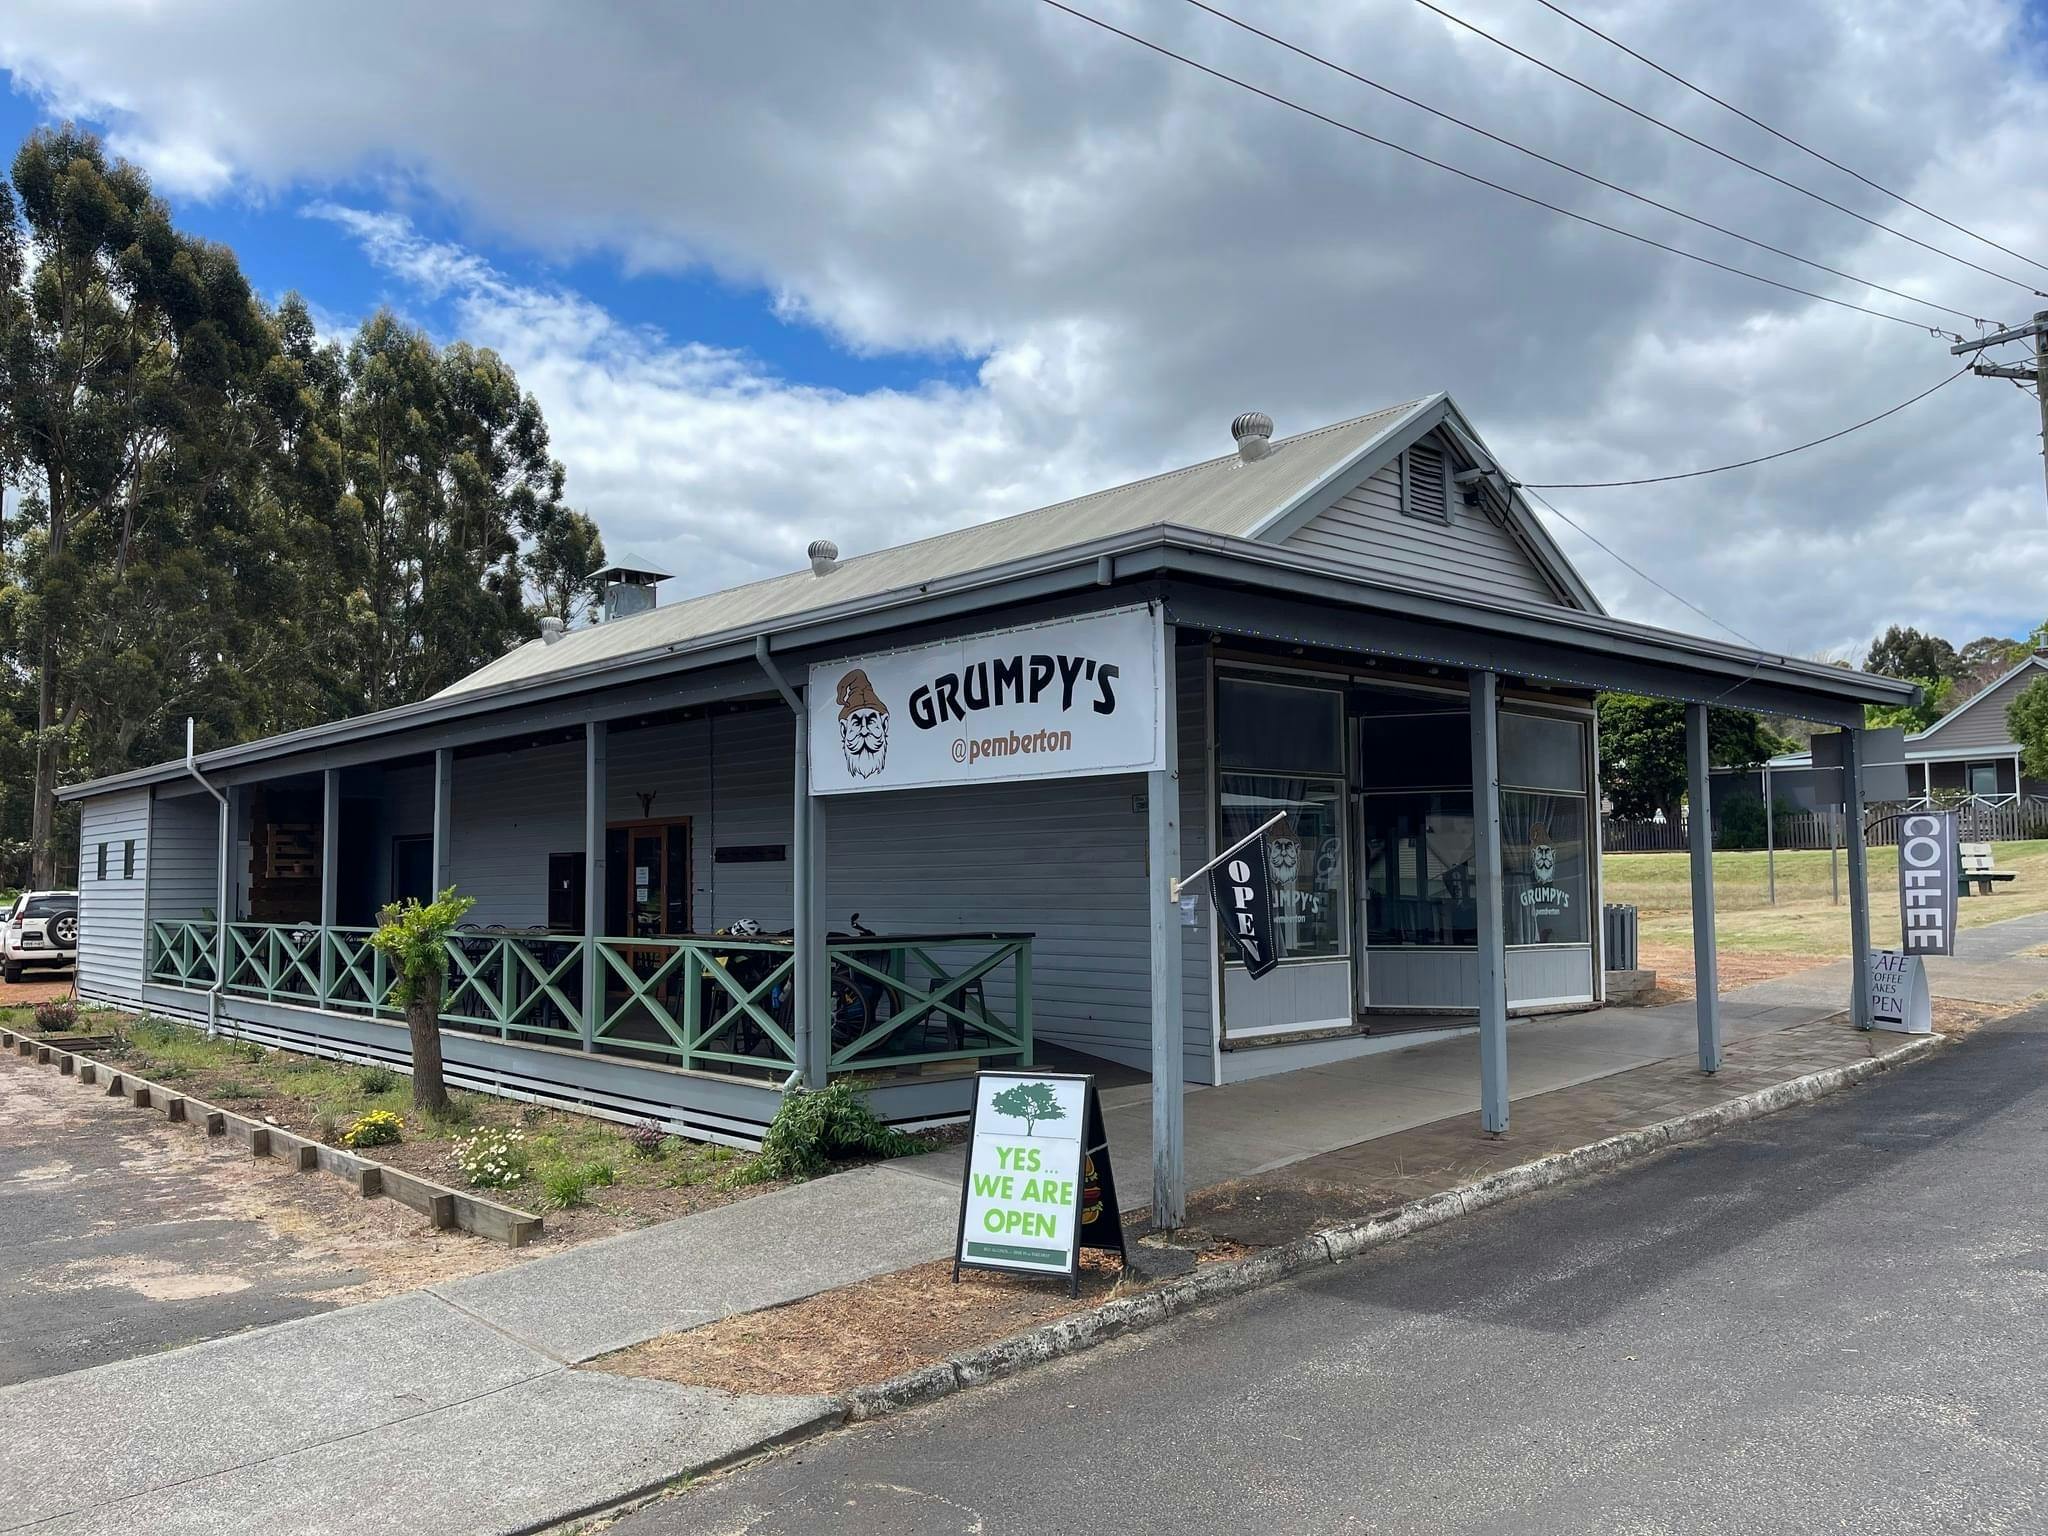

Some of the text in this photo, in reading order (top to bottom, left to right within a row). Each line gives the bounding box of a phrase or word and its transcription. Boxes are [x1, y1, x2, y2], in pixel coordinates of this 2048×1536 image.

[909, 655, 1120, 730] GRUMPY'S
[952, 729, 1071, 764] @pemberton
[1228, 860, 1261, 961] OPEN
[1272, 889, 1320, 914] UMPY'S
[1520, 887, 1570, 908] GRUMPY'S
[1872, 971, 1903, 984] OFFEE
[1872, 982, 1896, 994] AKES
[1872, 995, 1903, 1013] PEN
[973, 1174, 1073, 1206] WE ARE
[984, 1208, 1057, 1239] OPEN
